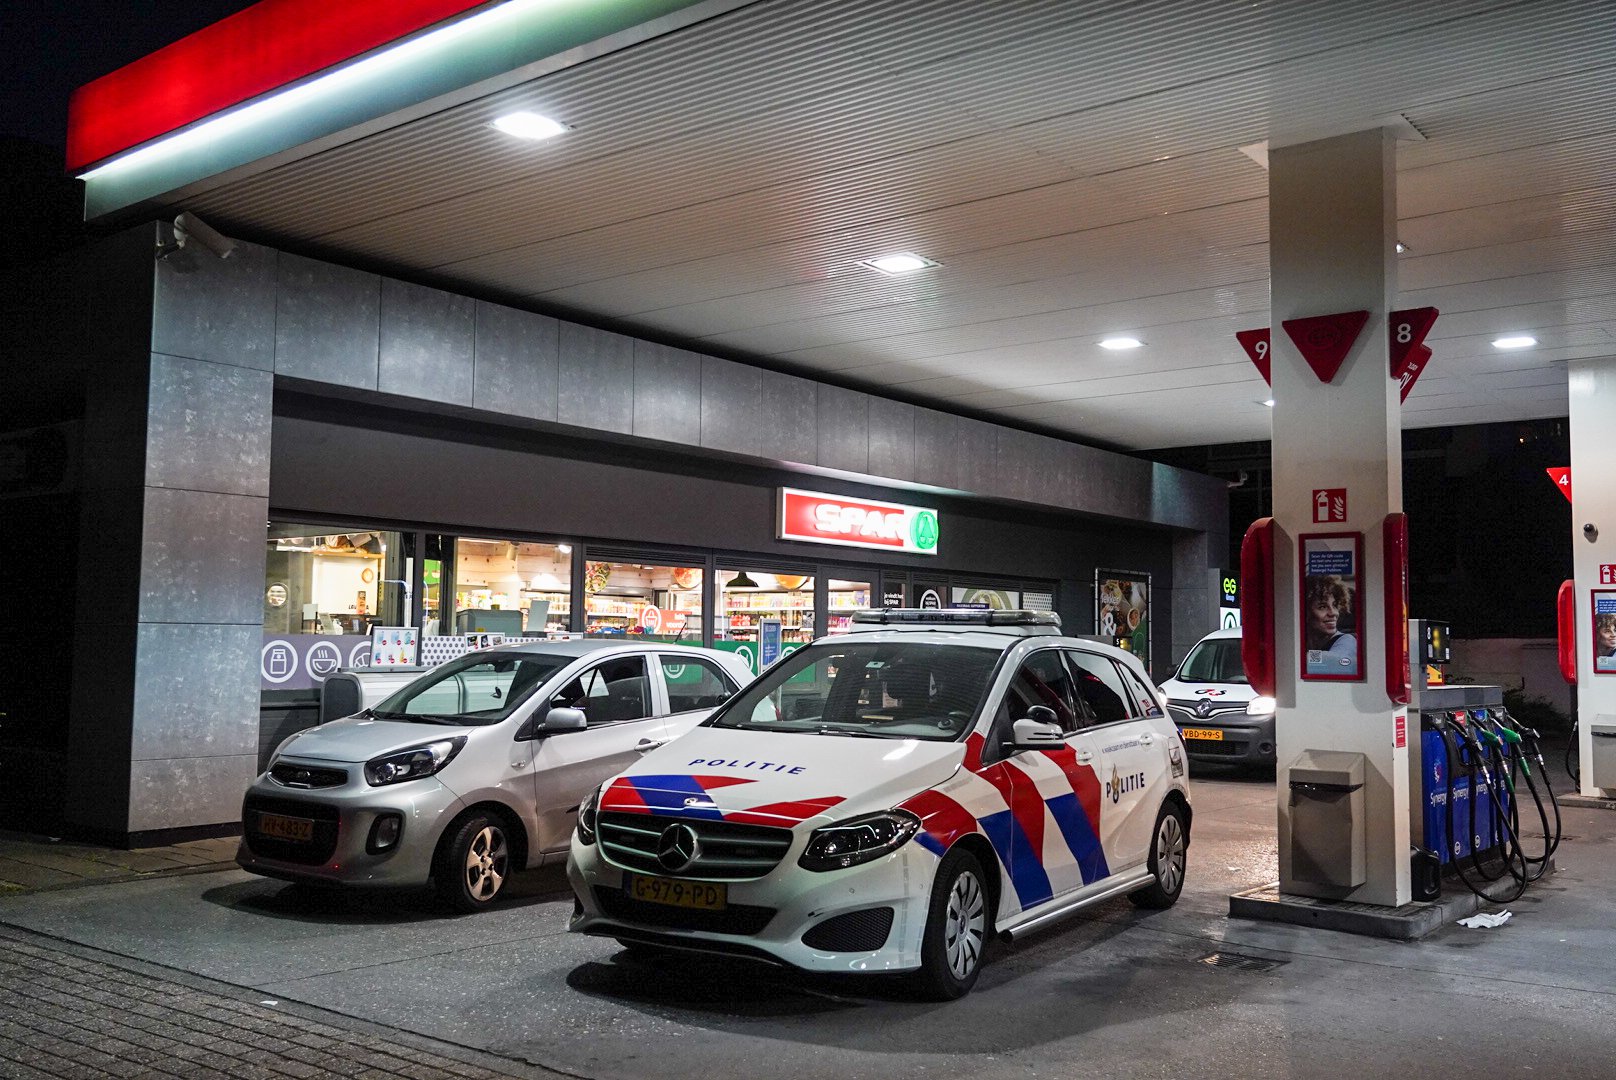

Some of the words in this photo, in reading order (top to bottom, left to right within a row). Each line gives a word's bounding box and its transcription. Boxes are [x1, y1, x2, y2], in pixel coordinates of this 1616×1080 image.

[1397, 323, 1411, 344] 8
[1255, 341, 1268, 360] 9
[1558, 474, 1569, 486] 4
[815, 503, 906, 540] SPAR
[1183, 729, 1221, 740] VBD-99-S
[688, 759, 807, 775] POLITIE
[1106, 772, 1145, 804] POLITIE
[635, 877, 718, 906] G-979-PD
